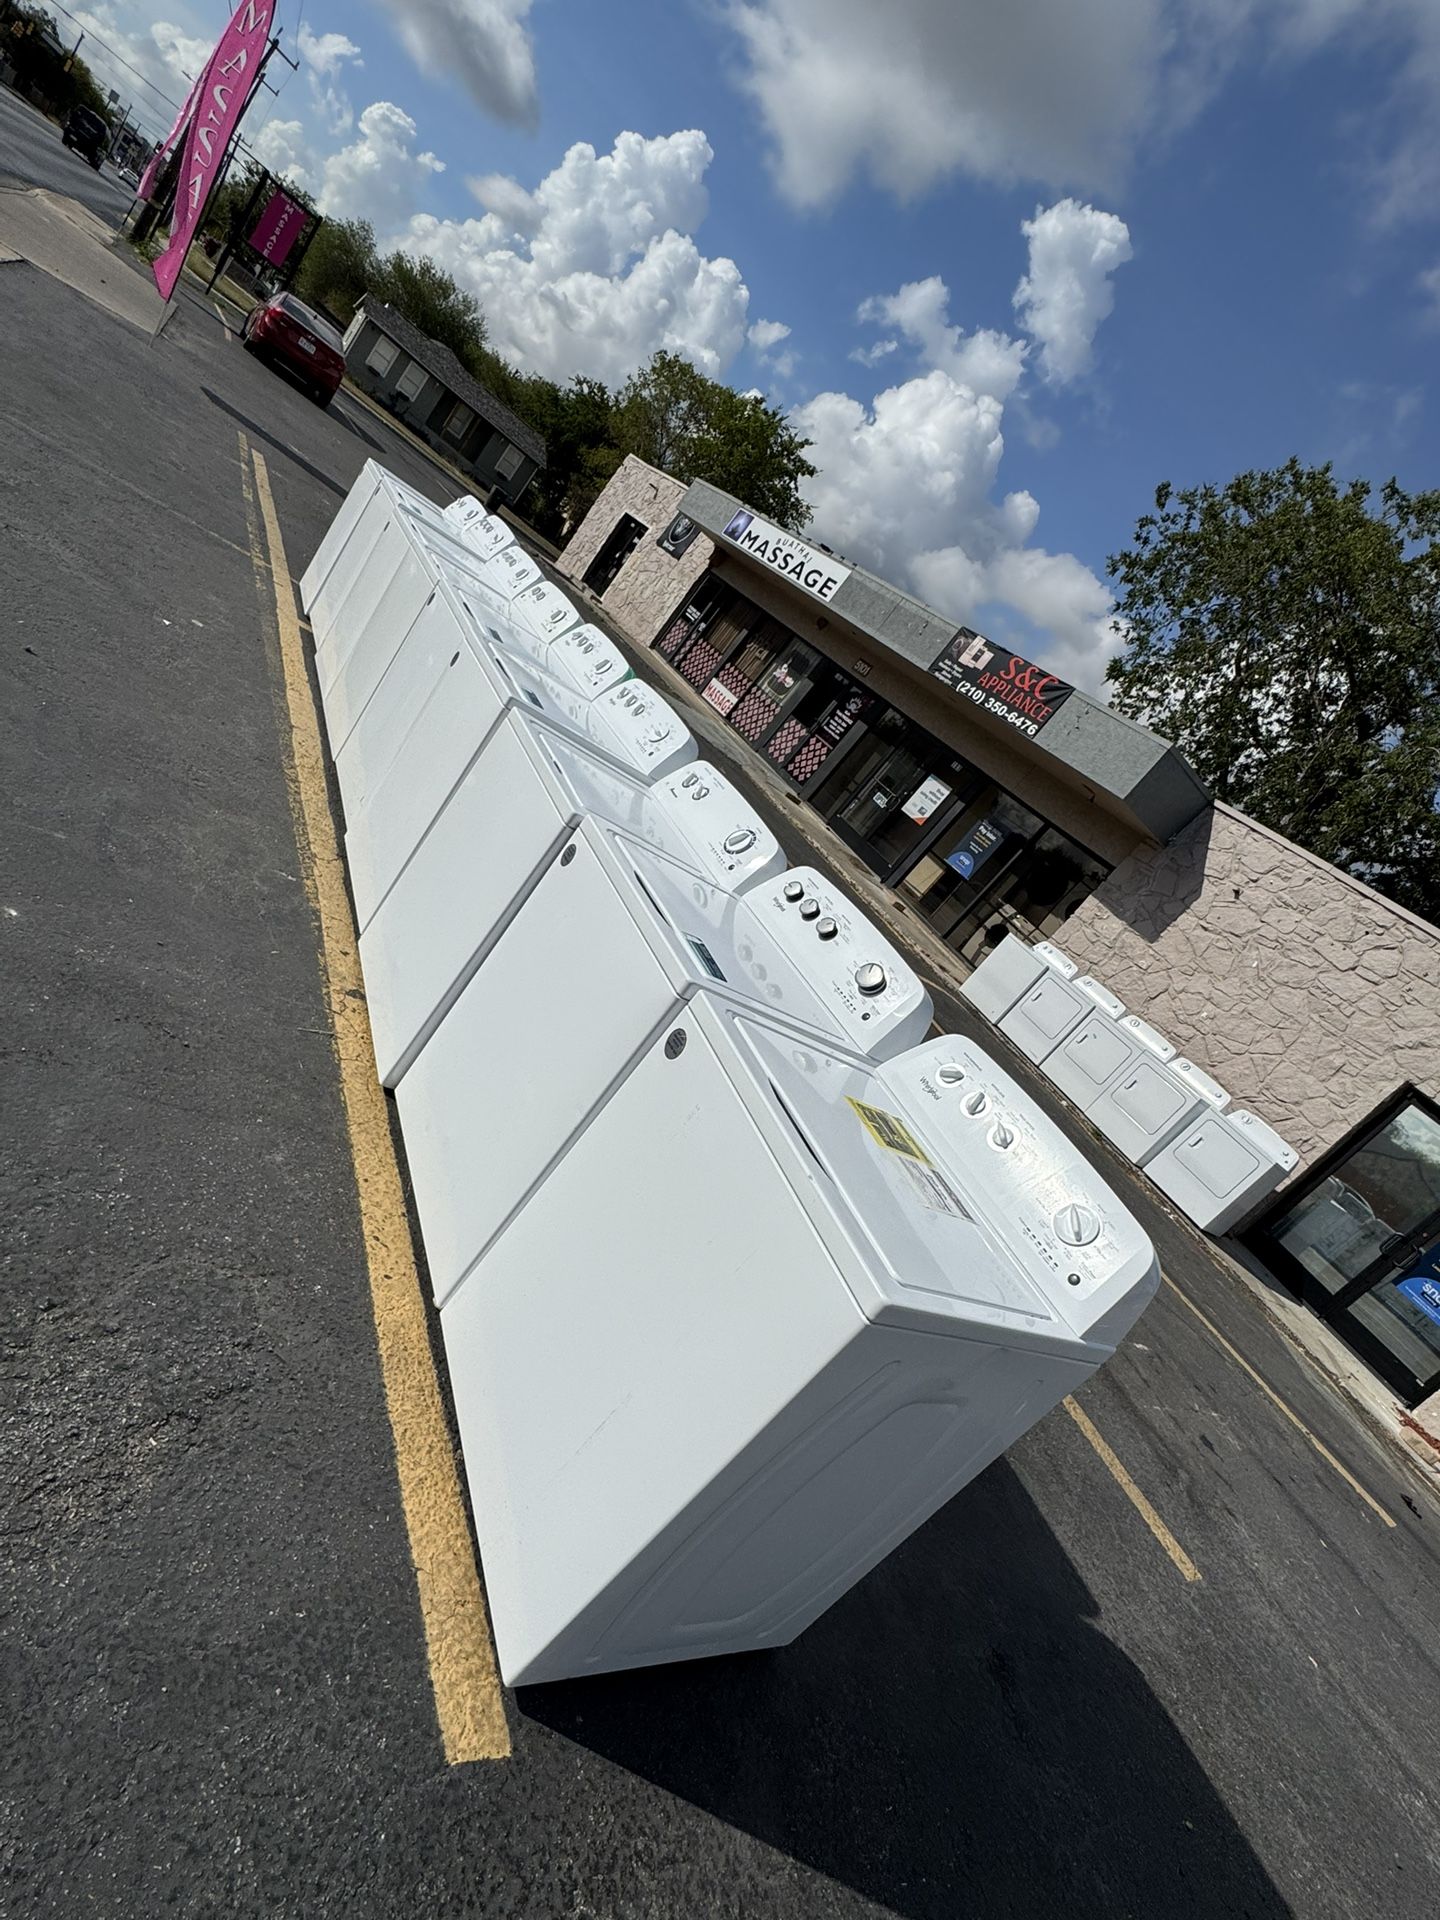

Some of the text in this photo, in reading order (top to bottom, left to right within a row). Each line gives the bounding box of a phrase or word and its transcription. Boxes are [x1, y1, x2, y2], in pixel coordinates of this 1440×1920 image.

[188, 2, 268, 220] MASSA
[263, 204, 294, 258] MASSAGE
[740, 530, 838, 598] MASSAGE
[704, 682, 734, 714] MASSAGE
[976, 671, 1053, 722] APPLIANCE
[999, 656, 1060, 700] S&C
[955, 680, 1039, 736] (210) 350-6476
